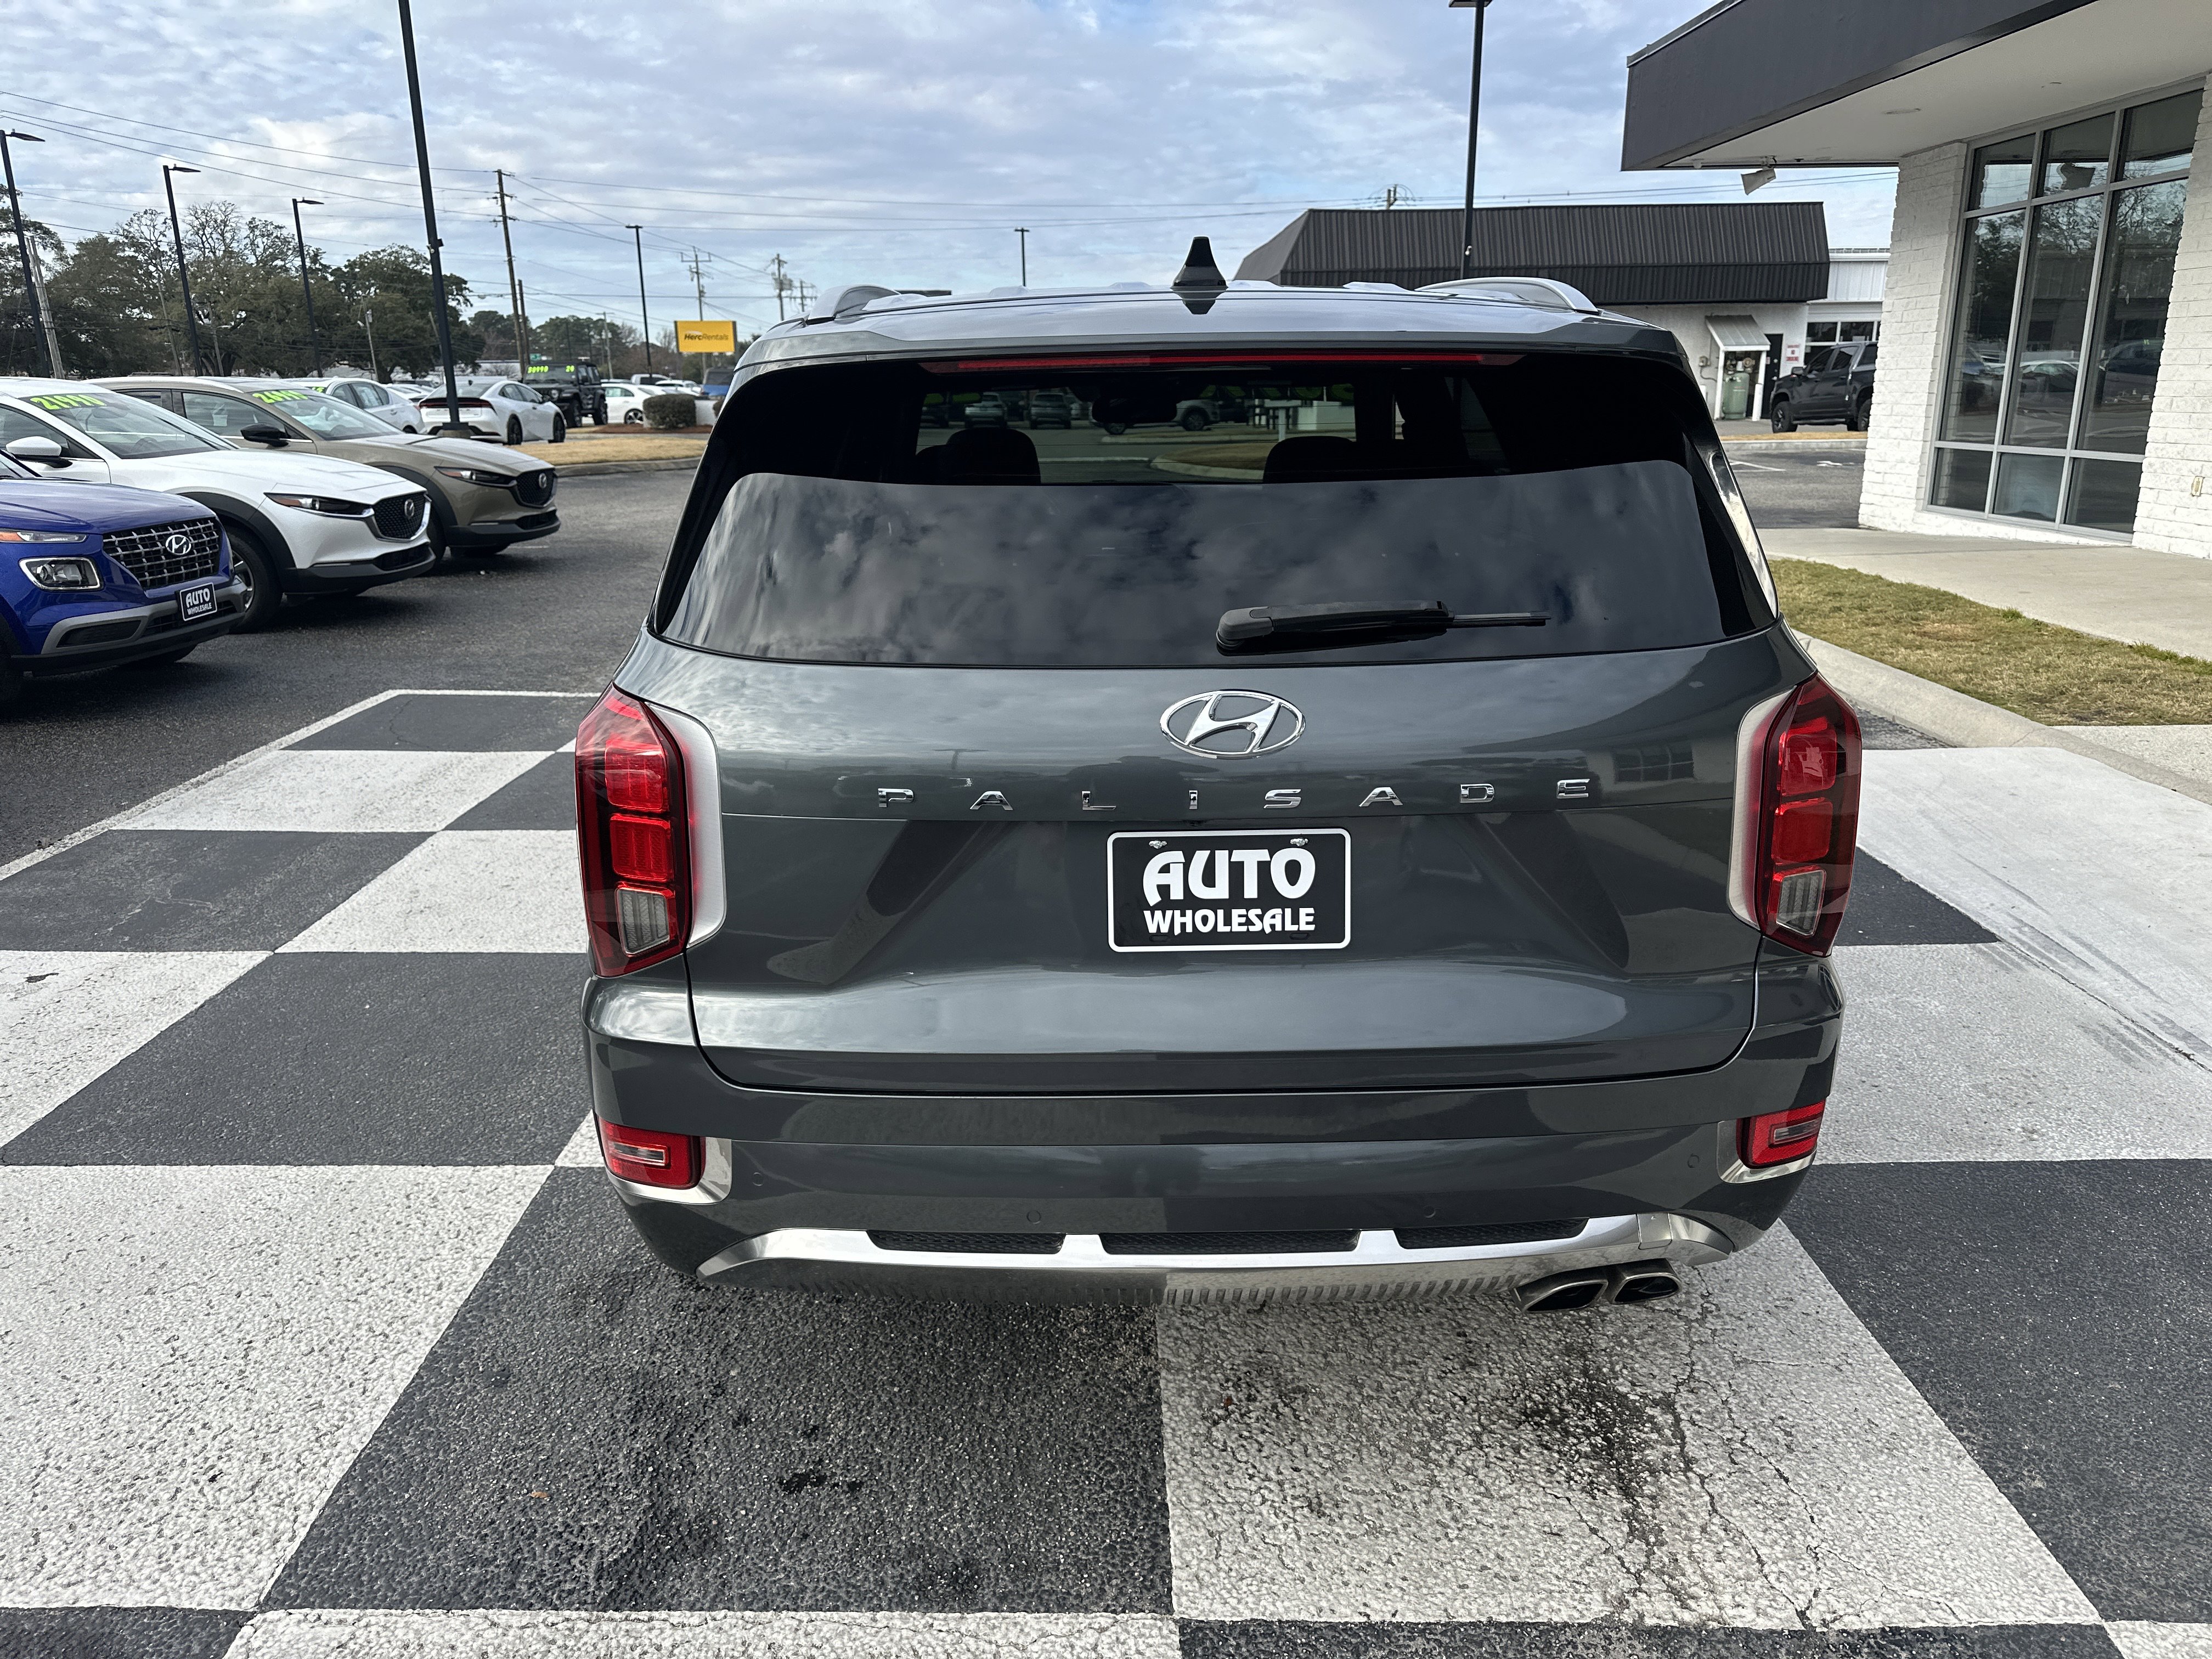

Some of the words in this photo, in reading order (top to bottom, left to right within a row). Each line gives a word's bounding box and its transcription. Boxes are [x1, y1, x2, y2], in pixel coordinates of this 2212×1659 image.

[30, 394, 106, 410] 21990
[185, 588, 210, 608] AUTO
[187, 602, 212, 615] WHOLESALE
[878, 778, 1590, 811] PALISADE
[1143, 848, 1316, 906] AUTO
[1143, 907, 1316, 936] WHOLESALE
